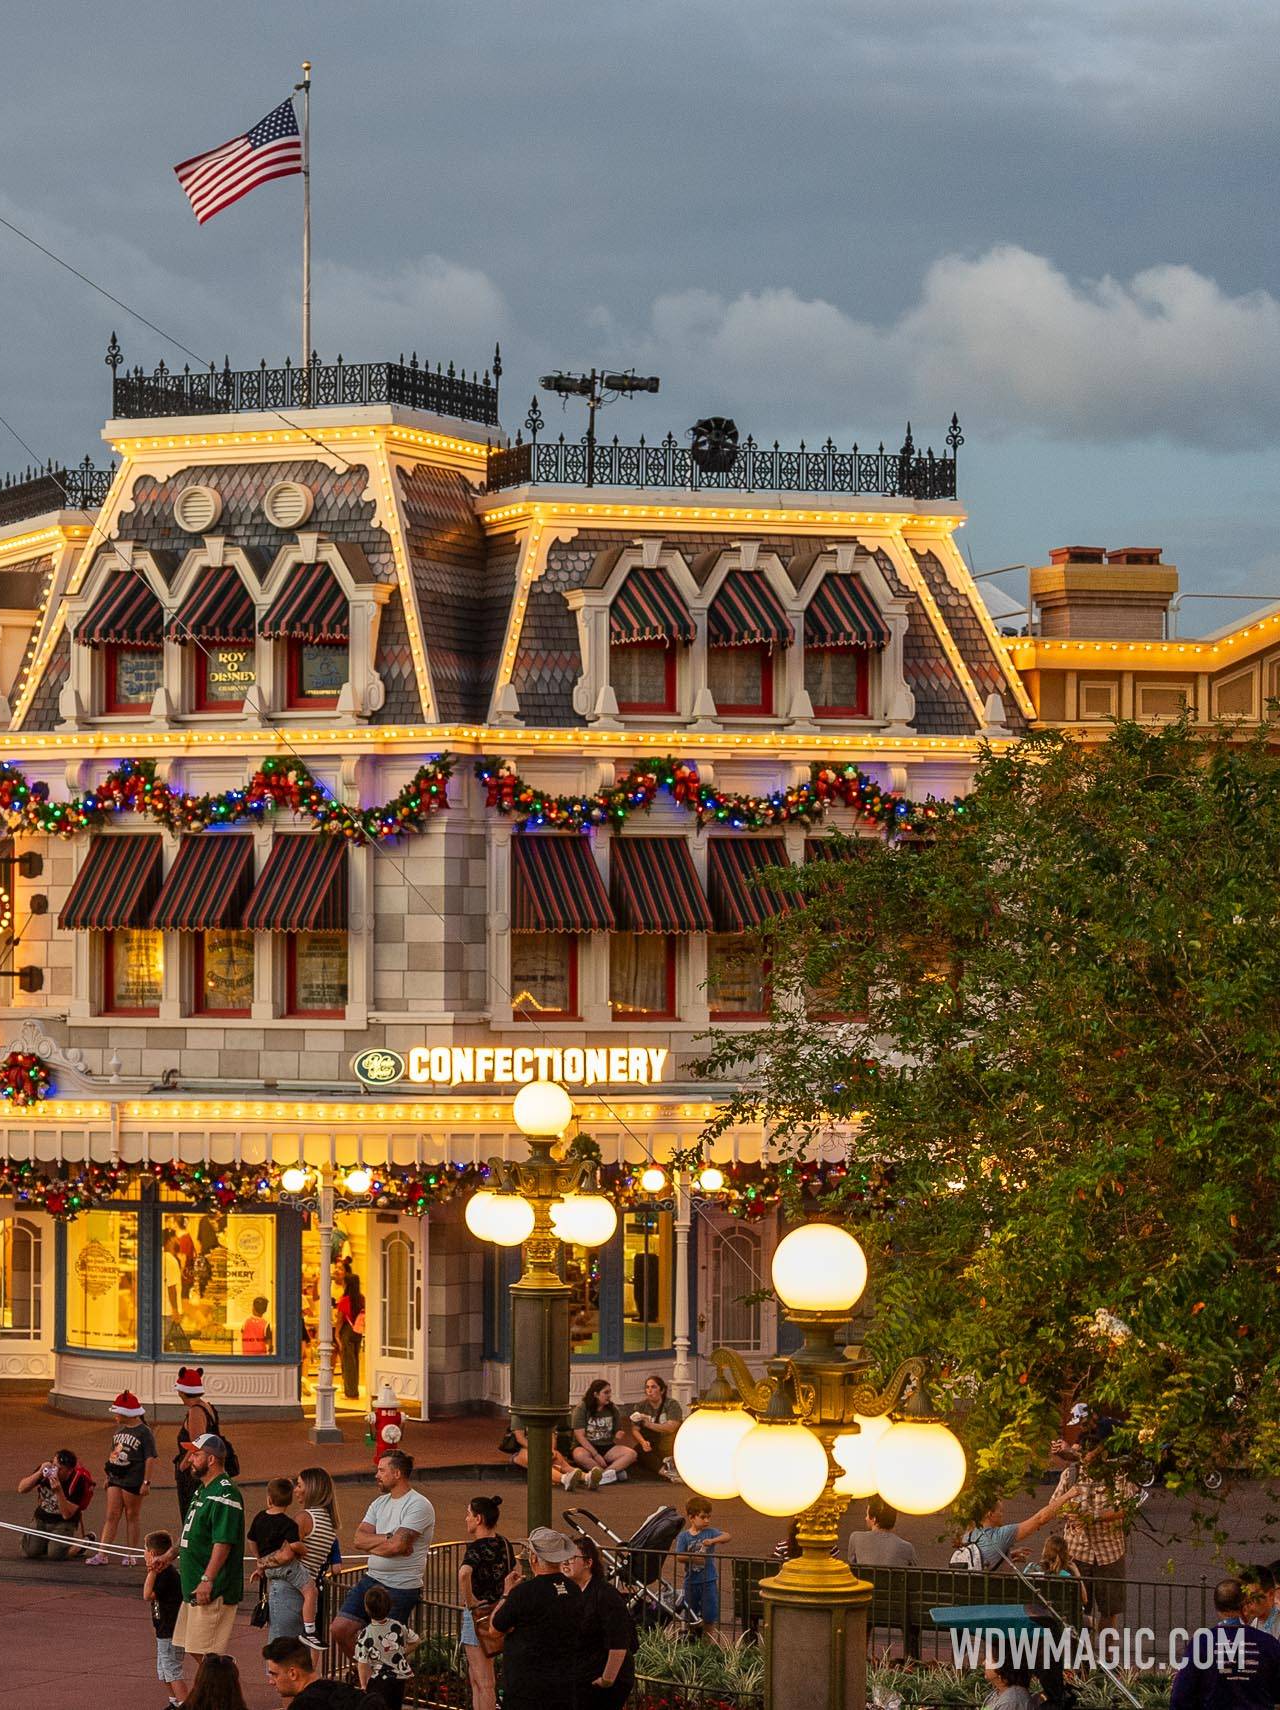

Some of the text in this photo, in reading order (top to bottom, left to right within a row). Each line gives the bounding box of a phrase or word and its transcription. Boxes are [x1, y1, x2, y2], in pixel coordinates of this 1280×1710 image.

[218, 652, 246, 663] ROY
[227, 662, 238, 672] O
[408, 1046, 669, 1087] CONFECTIONERY
[112, 1433, 141, 1450] MINNIE
